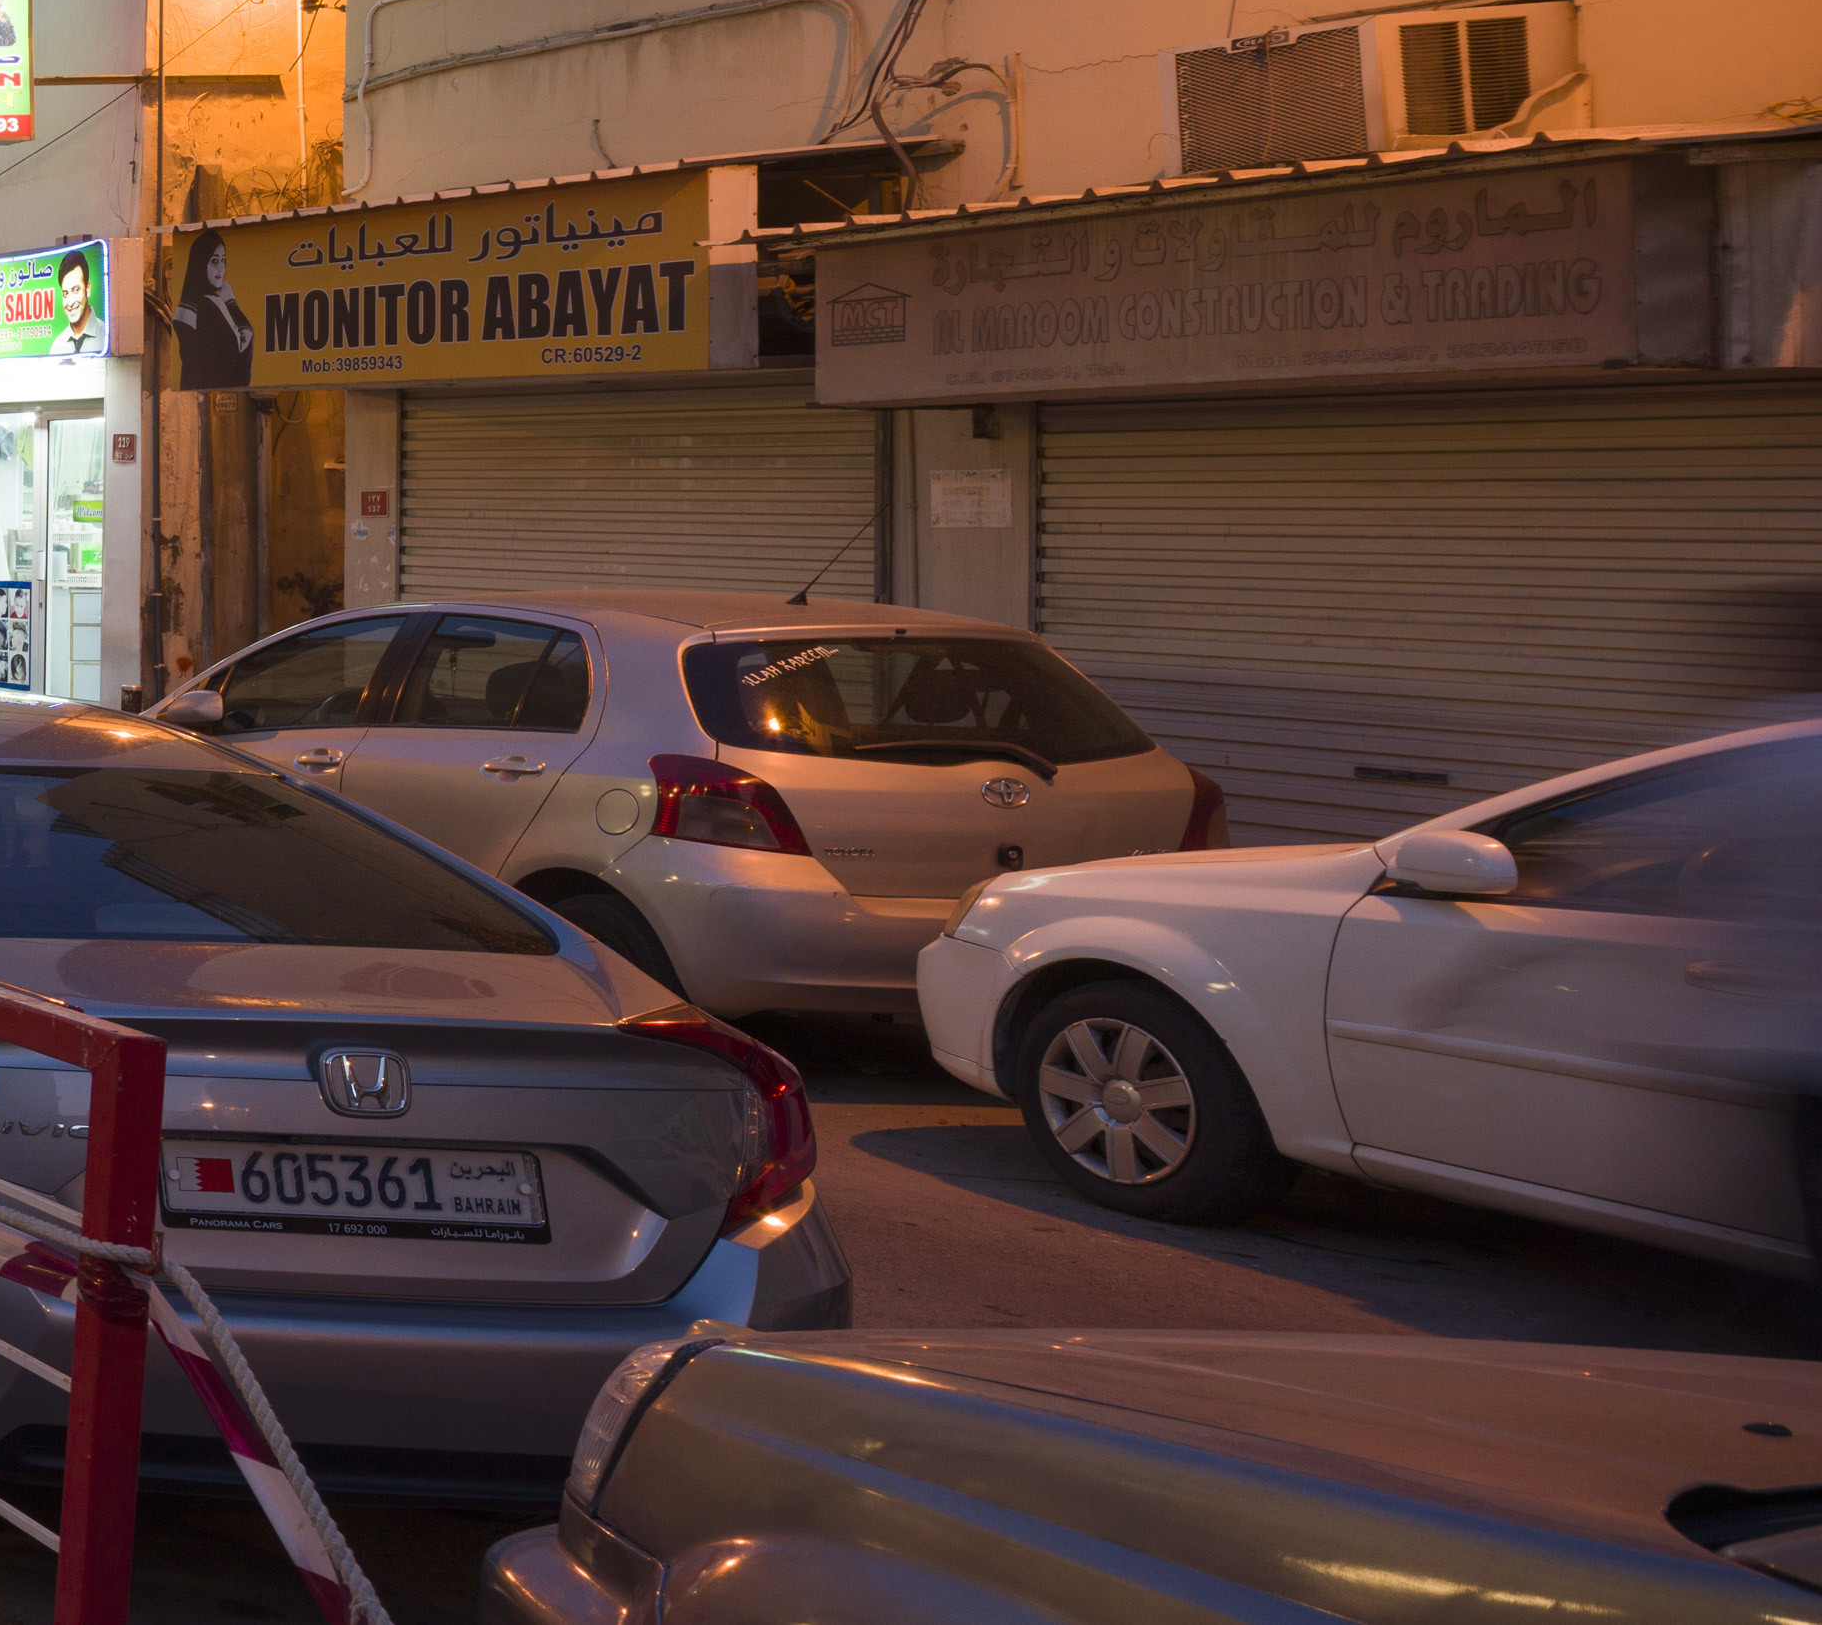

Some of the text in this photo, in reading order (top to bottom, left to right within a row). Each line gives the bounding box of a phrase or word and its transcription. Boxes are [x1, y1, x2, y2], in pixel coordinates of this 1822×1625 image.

[287, 201, 664, 272] مينياتور للعبايات
[9, 260, 54, 288] صالون
[5, 289, 54, 323] SALON
[265, 260, 696, 354] MONITOR ABAYAT
[841, 300, 898, 331] MCT
[934, 258, 1601, 356] AL MAROOM CONSTRUCTION & TRADING
[541, 345, 643, 365] CR:60529-2
[118, 437, 130, 448] 119
[240, 1151, 442, 1211] 605361
[448, 1160, 516, 1182] البحرين
[453, 1196, 521, 1215] BAHRAIN
[327, 1225, 387, 1235] 17 692 000
[431, 1227, 526, 1242] بانوراما للسيارات
